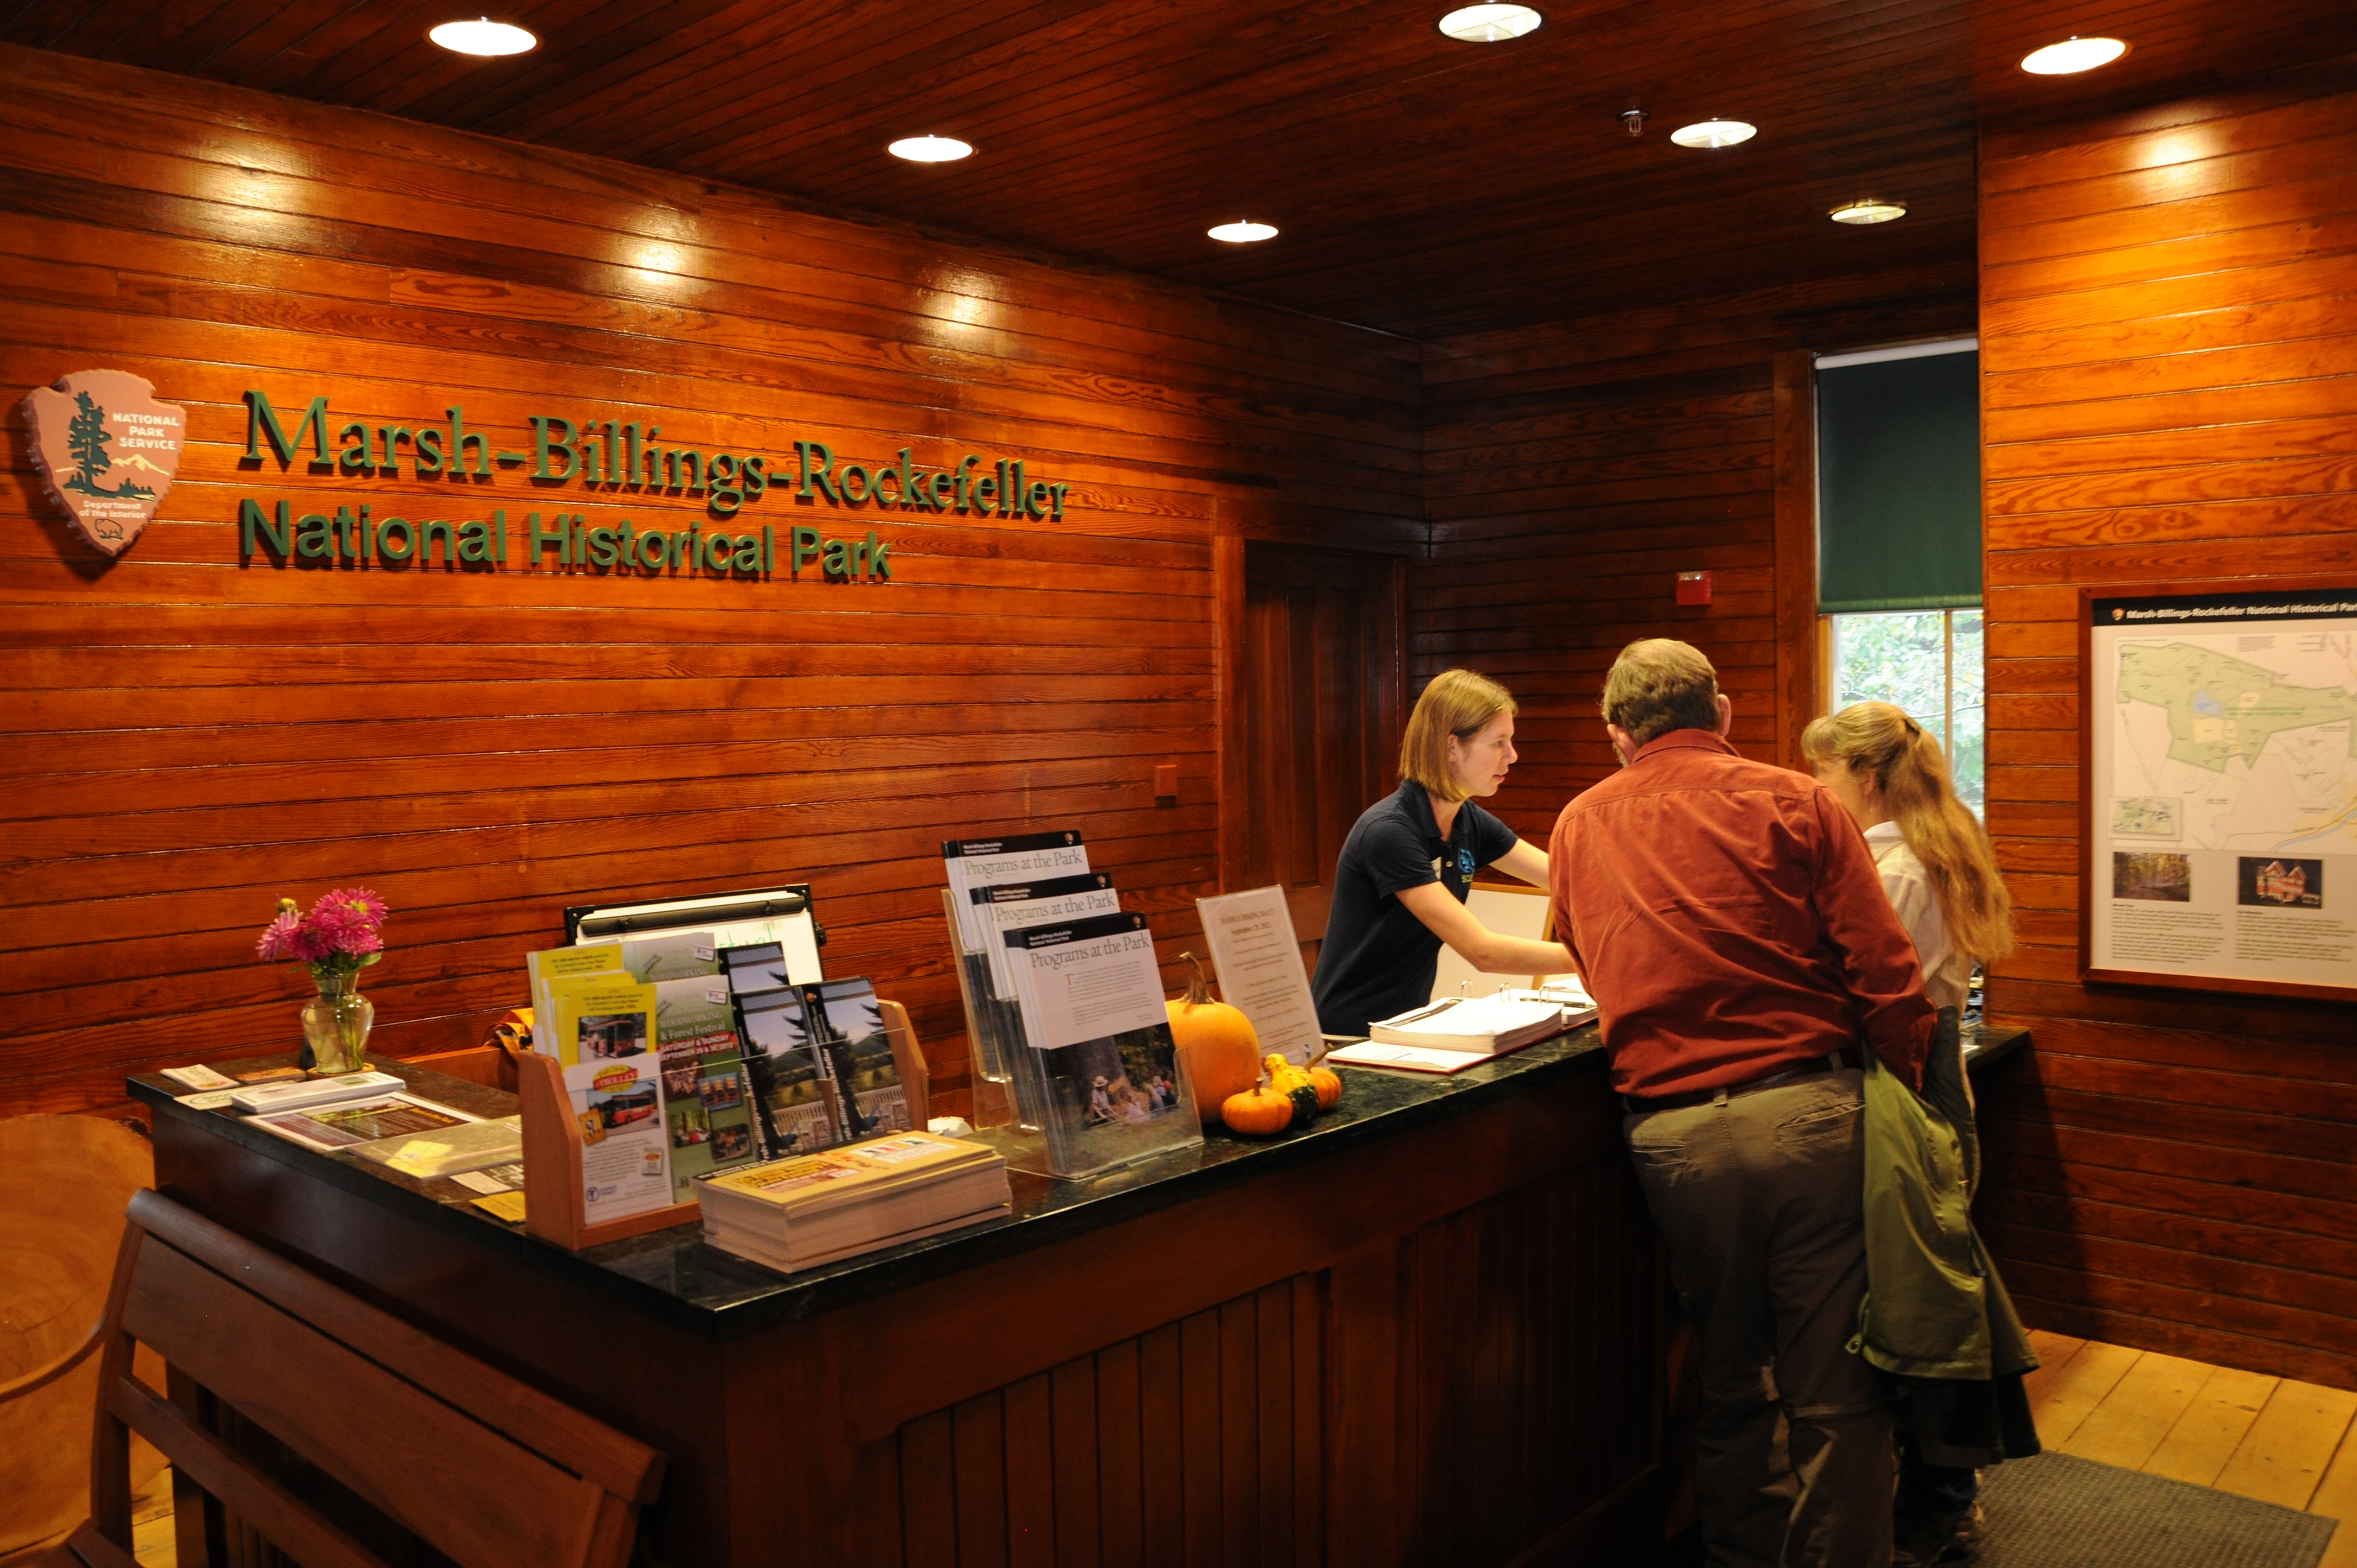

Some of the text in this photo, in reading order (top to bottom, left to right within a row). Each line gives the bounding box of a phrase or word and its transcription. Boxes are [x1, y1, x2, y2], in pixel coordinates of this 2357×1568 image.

[112, 413, 179, 426] NATIONAL
[129, 426, 165, 437] PARK
[119, 437, 176, 450] SERVICE
[242, 390, 1070, 516] Marsh-Billings-Rockefeller
[84, 500, 142, 510] Department
[109, 510, 147, 519] Interior
[241, 498, 893, 577] National Historical Park
[2127, 606, 2245, 619] Marsh-Billings-Rockefeller
[2246, 604, 2290, 615] National
[2290, 602, 2340, 614] Historical
[965, 849, 1083, 879] Programs at the Park
[995, 892, 1116, 925] Programs at the Park
[1030, 932, 1150, 970] Programs at the Park
[660, 1011, 723, 1029] WOODWORKING
[661, 1020, 726, 1041] & Forest Festival
[659, 1034, 729, 1053] SATURDAY & SUNDAY
